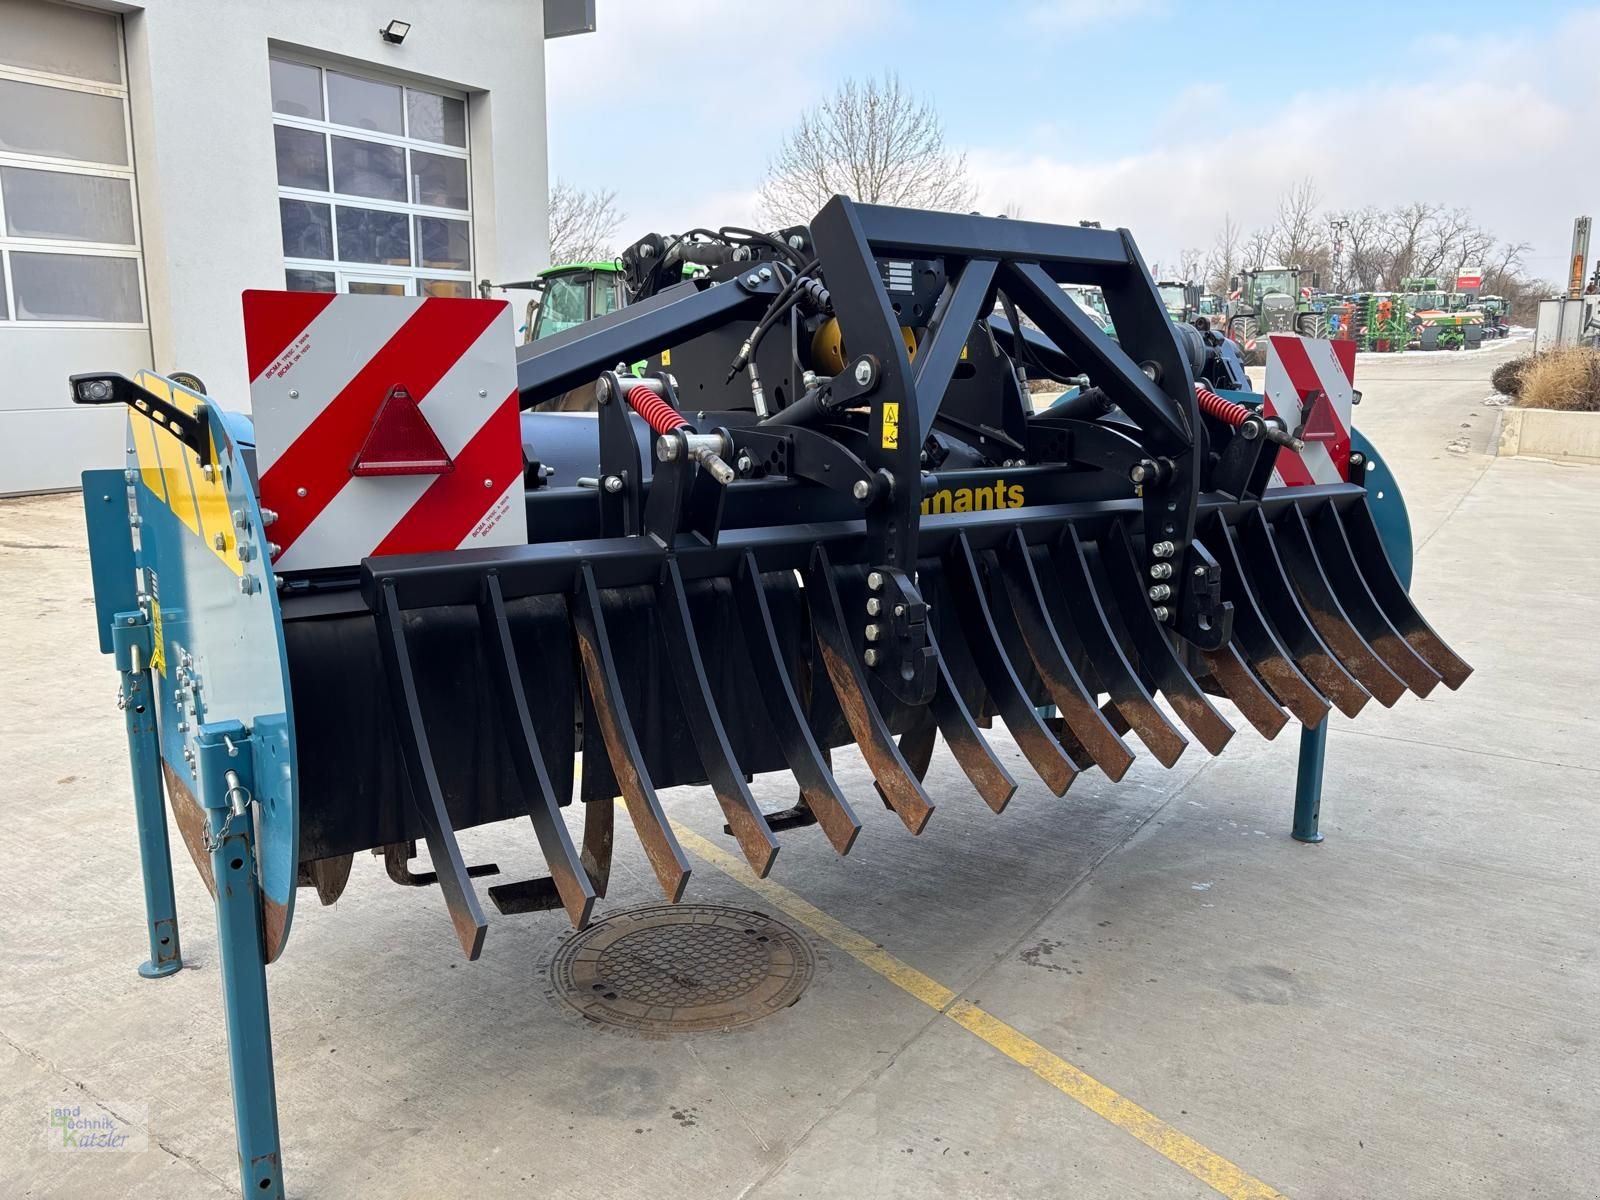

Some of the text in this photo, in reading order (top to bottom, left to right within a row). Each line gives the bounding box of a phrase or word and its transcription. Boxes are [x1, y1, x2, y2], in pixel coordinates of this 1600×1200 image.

[265, 361, 281, 379] BICMA
[277, 361, 294, 378] BICMA
[472, 522, 486, 537] BICMA
[481, 521, 495, 536] BICMA
